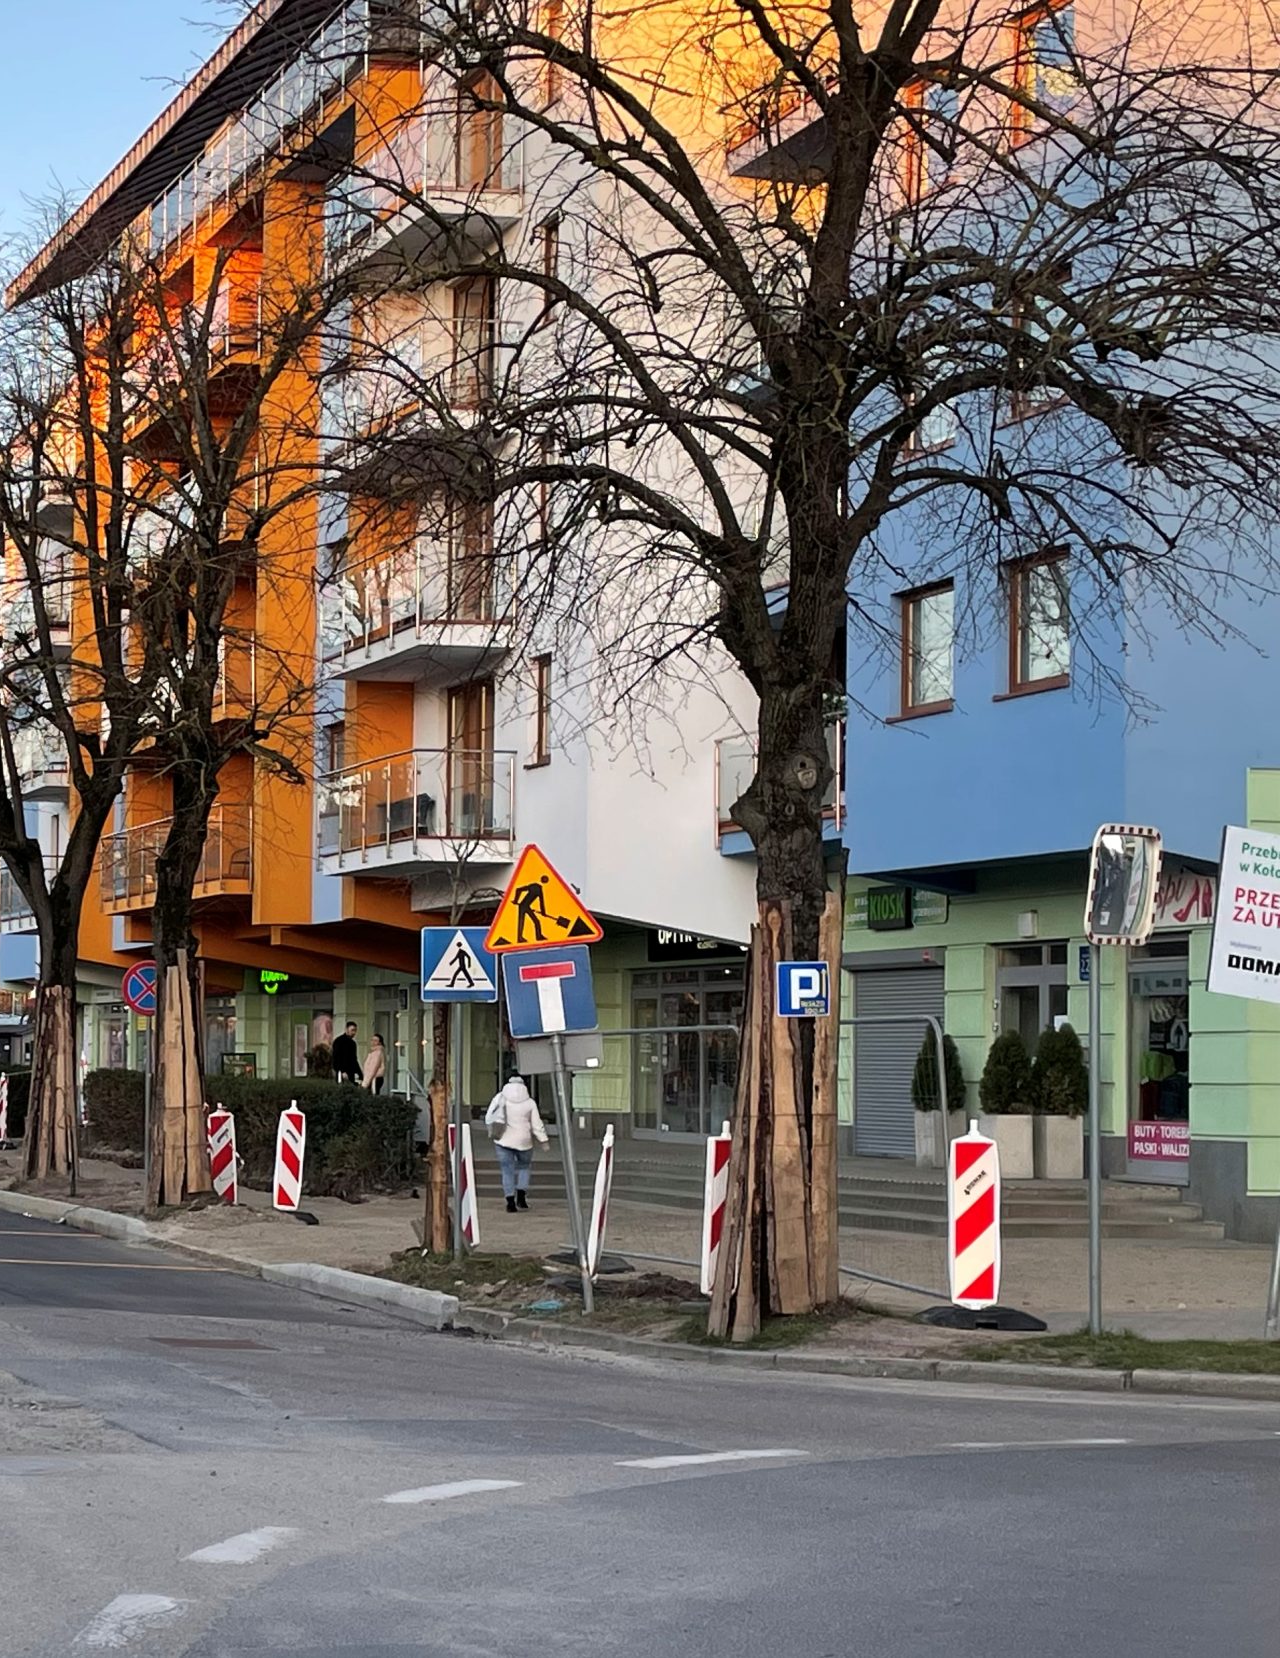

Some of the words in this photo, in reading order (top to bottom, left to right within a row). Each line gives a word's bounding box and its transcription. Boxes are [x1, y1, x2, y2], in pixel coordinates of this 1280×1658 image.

[1241, 841, 1280, 860] Przeb
[1239, 862, 1250, 873] w
[869, 891, 905, 921] KIOSK
[1232, 905, 1256, 925] ZA
[790, 968, 820, 1010] P
[1134, 1124, 1157, 1138] BUTY
[1133, 1141, 1158, 1155] PASKI
